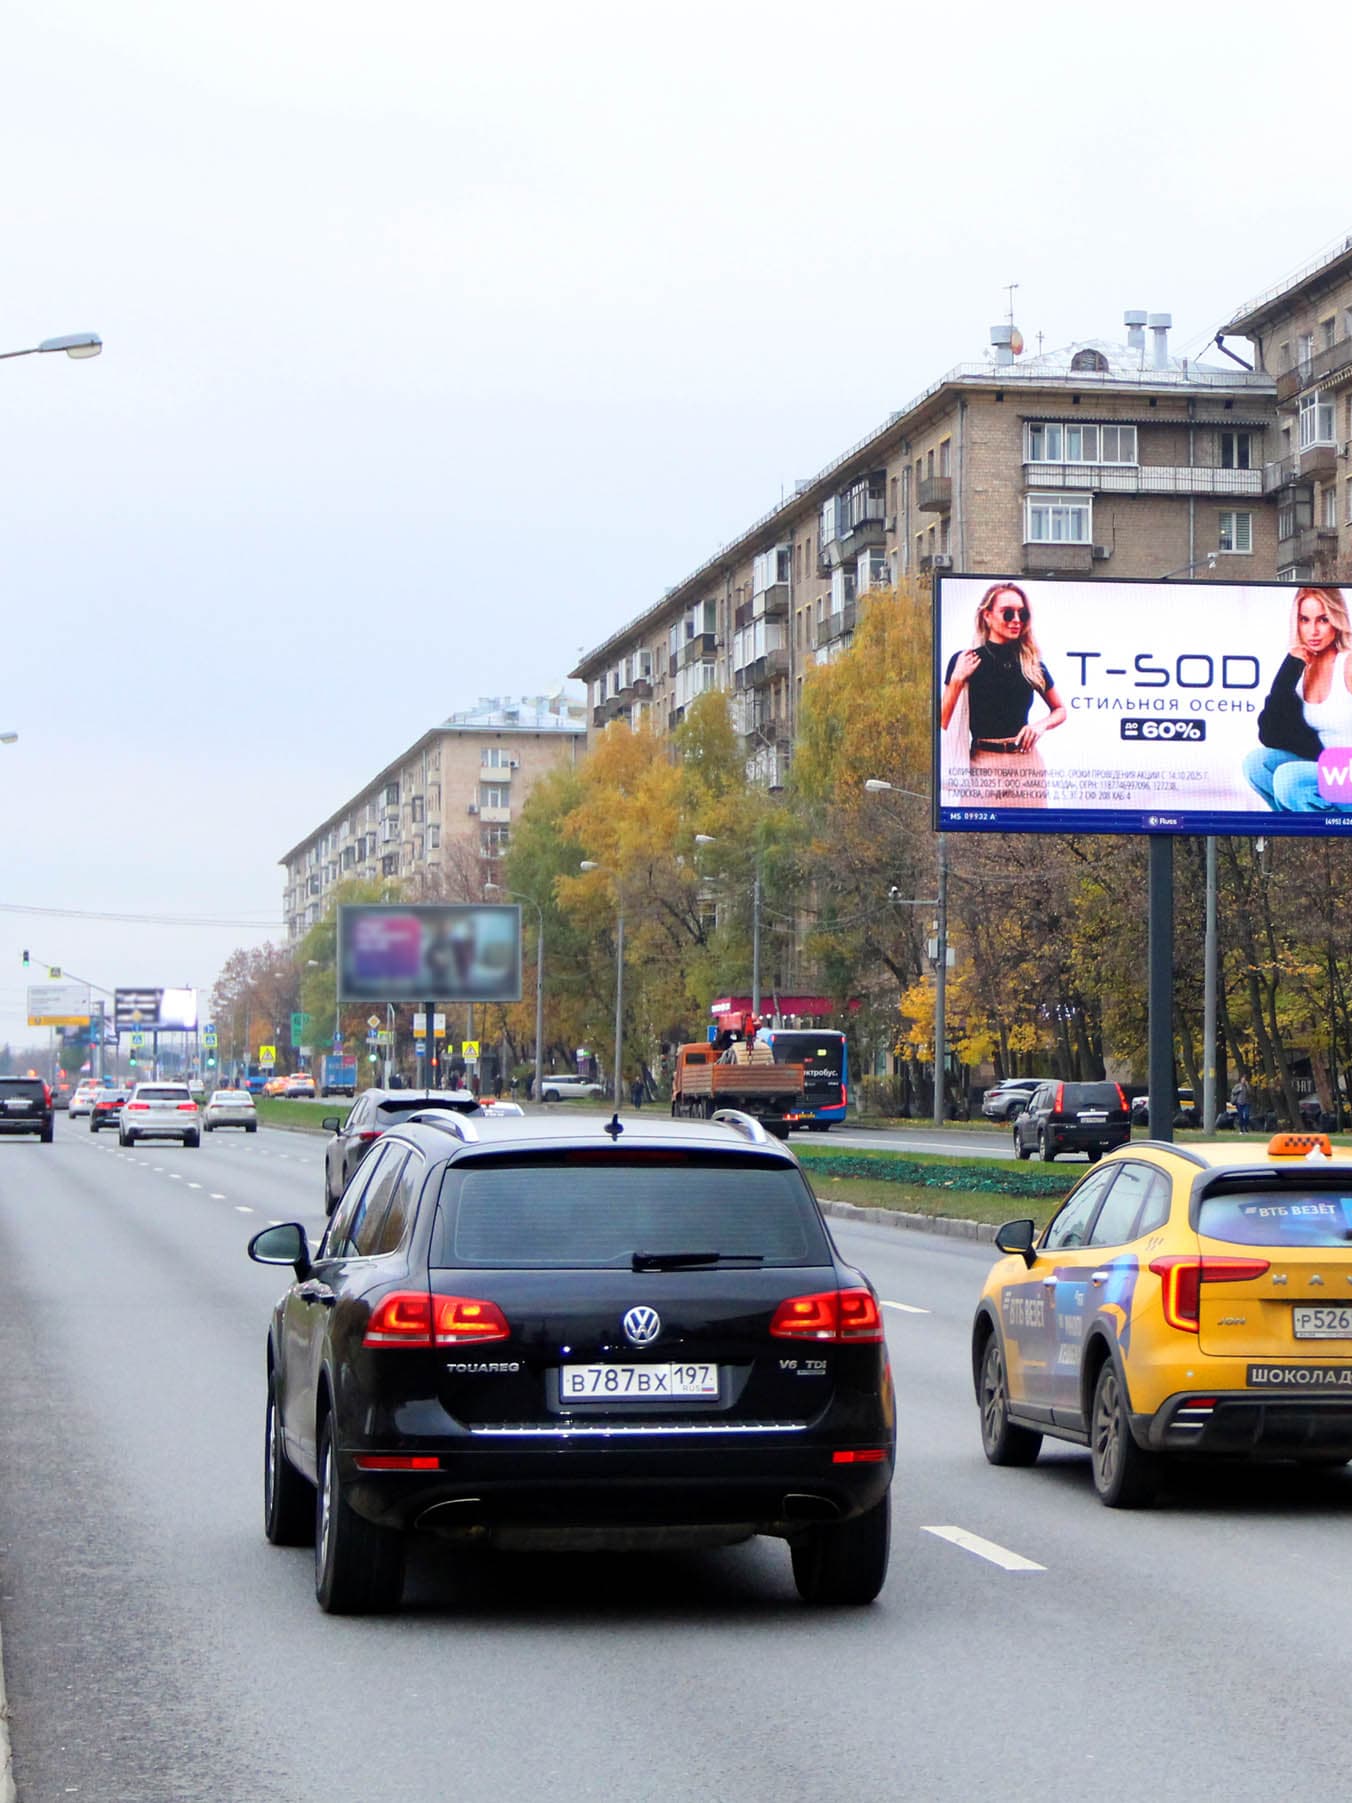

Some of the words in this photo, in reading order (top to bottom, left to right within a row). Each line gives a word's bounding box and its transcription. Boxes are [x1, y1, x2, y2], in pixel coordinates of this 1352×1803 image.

[1066, 652, 1260, 689] T-SOD
[1071, 697, 1179, 711] стильная
[1189, 699, 1256, 713] осень
[1259, 1207, 1288, 1217] ВТБ
[1291, 1203, 1336, 1215] ВЕЗЁТ
[446, 1363, 520, 1373] TOUAREG
[779, 1360, 798, 1369] V6
[572, 1369, 668, 1392] В787ВХ
[674, 1366, 710, 1384] 197
[1252, 1369, 1352, 1384] ШОКОЛАД
